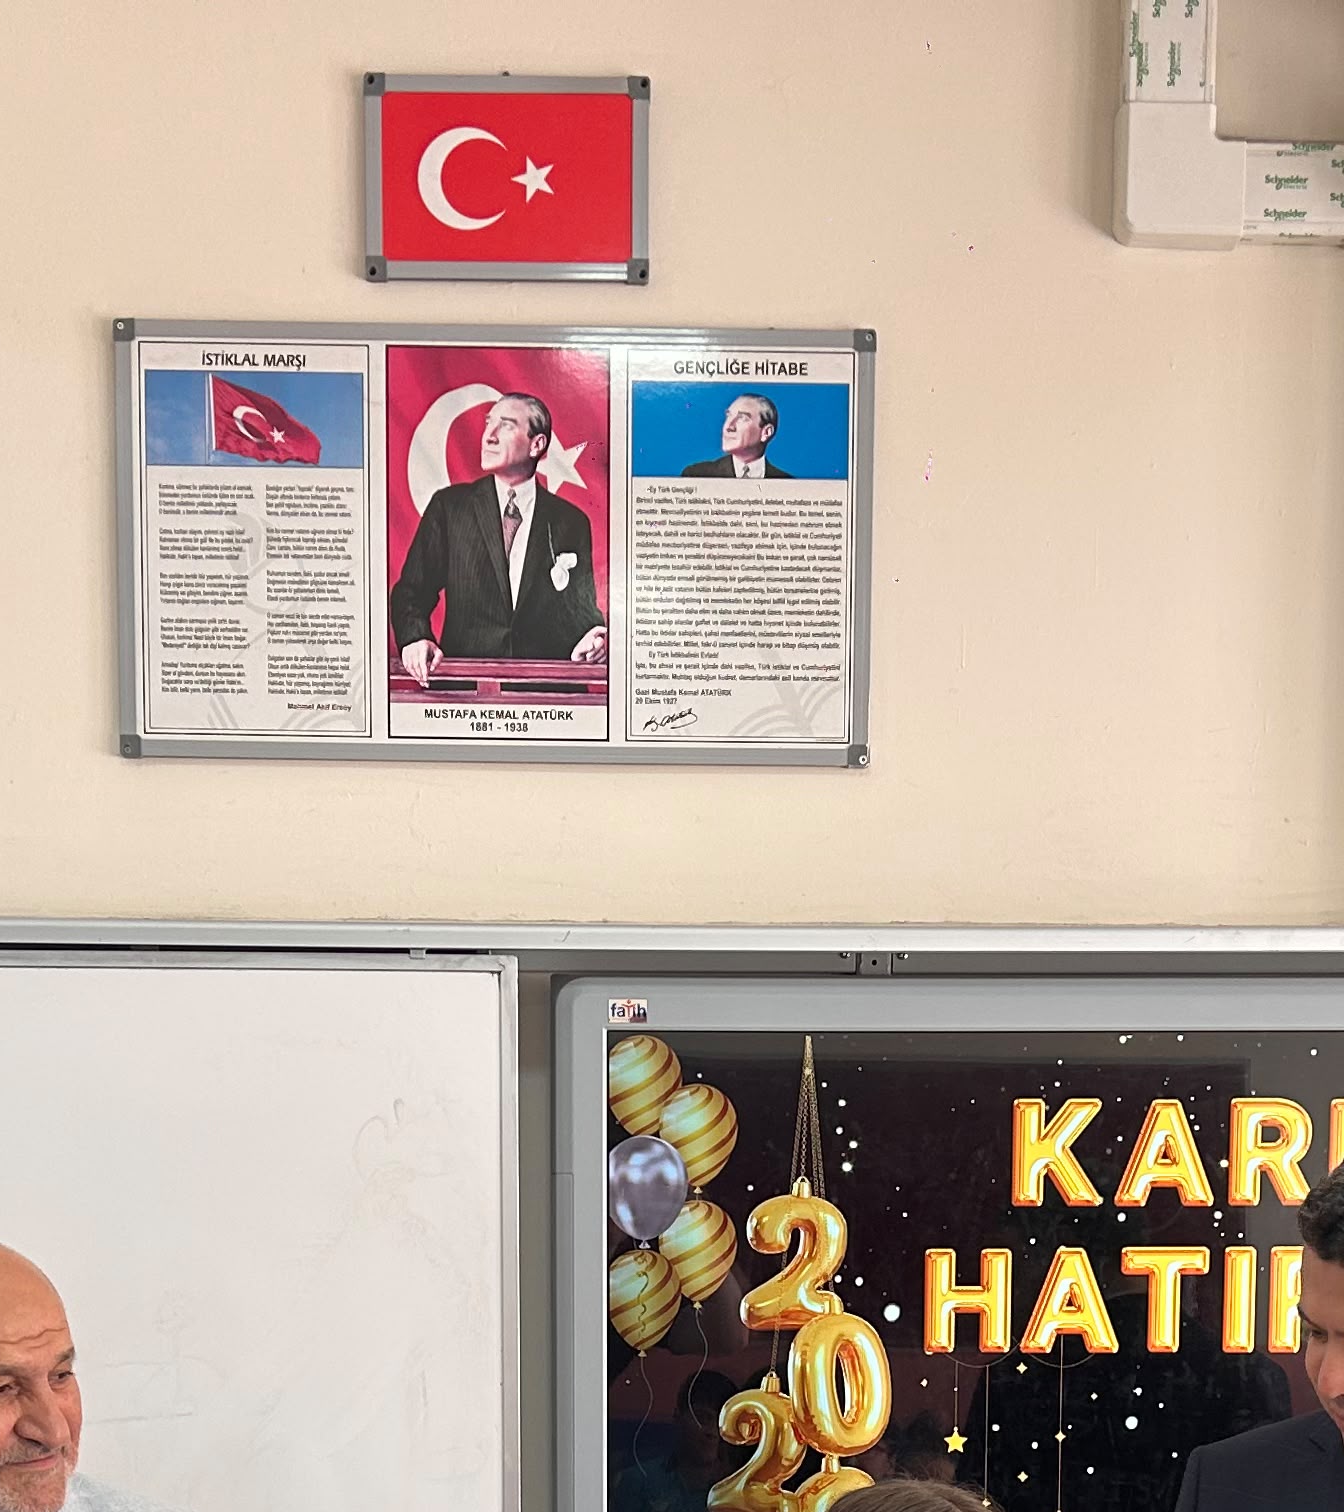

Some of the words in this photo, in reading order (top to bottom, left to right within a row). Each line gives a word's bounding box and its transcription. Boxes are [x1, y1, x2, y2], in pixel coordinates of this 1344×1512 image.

[1167, 41, 1181, 86] Schneider
[1265, 175, 1308, 190] Schneider
[1264, 208, 1307, 222] Schneider
[202, 350, 259, 366] İSTİKLAL
[263, 354, 306, 371] MARŞI
[674, 358, 750, 377] GENÇLİĞE
[755, 359, 808, 376] HİTABE
[424, 709, 477, 719] MUSTAFA
[480, 710, 519, 720] KEMAL
[523, 709, 574, 720] ATATÜRK
[470, 722, 493, 731] 1881
[505, 722, 529, 732] 1938
